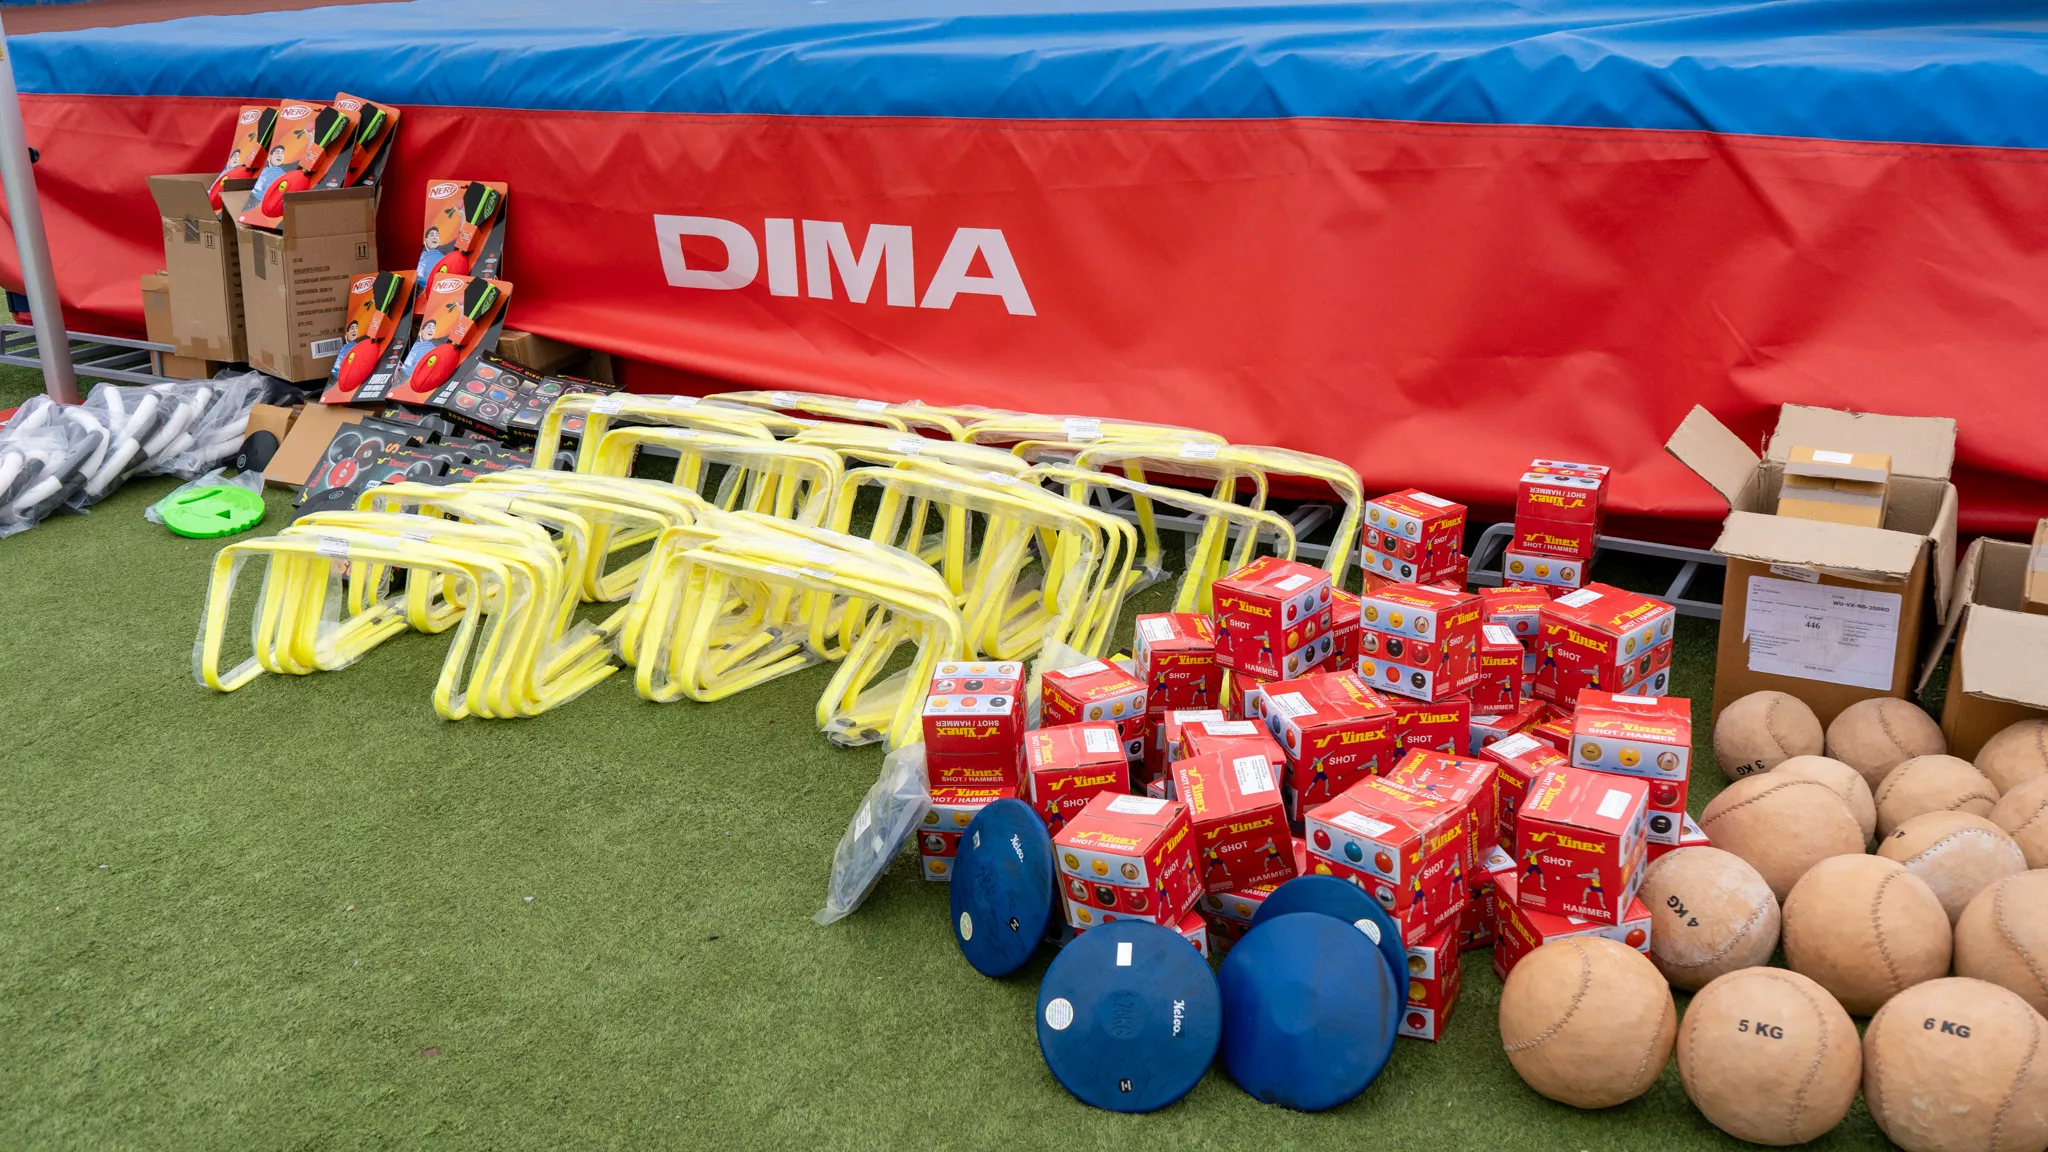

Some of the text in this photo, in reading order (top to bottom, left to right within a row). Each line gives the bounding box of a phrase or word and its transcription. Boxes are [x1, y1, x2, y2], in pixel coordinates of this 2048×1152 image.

[282, 107, 310, 118] NERF
[430, 184, 458, 198] NERF
[653, 214, 1037, 316] DIMA
[434, 280, 464, 293] NERF
[1529, 493, 1565, 507] Vinex
[1530, 487, 1587, 499] SHOT HAMMER
[1440, 516, 1462, 530] Vinex
[1434, 535, 1448, 545] SHOT
[1522, 541, 1579, 554] SHOT HAMMER
[1543, 534, 1580, 548] Vinex
[1436, 565, 1457, 577] HAMMER
[1238, 600, 1272, 618] Vinex
[1621, 601, 1656, 619] Vinex
[1229, 619, 1251, 630] SHOT
[1457, 610, 1480, 625] Vinex
[1620, 606, 1665, 631] SHOT HAMMER
[1804, 621, 1821, 630] 446
[1449, 635, 1465, 647] SHOT
[1567, 628, 1608, 654] Vinex
[1178, 655, 1214, 665] Vinex
[1481, 656, 1518, 665] Vinex
[1557, 648, 1581, 662] SHOT
[1245, 662, 1279, 678] HAMMER
[1101, 679, 1134, 693] Vinex
[1456, 672, 1479, 687] HAMMER
[1111, 685, 1139, 697] HAMMER
[1336, 676, 1364, 702] Vinex
[1348, 674, 1387, 709] SHOT HAMMER
[1054, 691, 1077, 716] Vinex
[1048, 706, 1061, 720] SHOT
[1418, 712, 1460, 724] Vinex
[936, 727, 978, 738] Vinex
[1622, 722, 1676, 736] Vinex
[1626, 731, 1676, 742] HAMMER
[1340, 729, 1386, 745] Vinex
[1407, 735, 1433, 743] SHOT
[1329, 754, 1357, 765] SHOT
[963, 767, 1003, 777] Vinex
[1735, 759, 1765, 776] 3 KG
[1073, 773, 1117, 788] Vinex
[1179, 768, 1189, 785] SHOT
[955, 787, 1001, 797] Vinex
[1192, 780, 1206, 814] Vinex
[1367, 781, 1414, 801] Vinex
[1376, 777, 1447, 803] SHOT HAMMER
[1528, 771, 1556, 809] SHOT HAMMER
[1063, 798, 1090, 808] SHOT
[1537, 785, 1562, 811] Vinex
[1229, 817, 1274, 835] Vinex
[1069, 837, 1135, 852] SHOT HAMMER
[1097, 832, 1141, 846] Vinex
[1165, 823, 1189, 854] Vinex
[1430, 823, 1463, 853] Vinex
[1556, 834, 1606, 854] Vinex
[1221, 841, 1248, 853] SHOT
[1542, 855, 1573, 867] SHOT
[1164, 859, 1179, 879] SHOT
[1248, 867, 1292, 884] HAMMER
[1423, 859, 1444, 879] SHOT
[1181, 883, 1202, 912] HAMMER
[1434, 899, 1464, 926] HAMMER
[1563, 903, 1611, 919] HAMMER
[1666, 894, 1700, 928] 4 KG
[1511, 911, 1536, 948] Vinex
[1738, 1019, 1784, 1040] 5 KG
[1923, 1017, 1971, 1039] 6 KG
